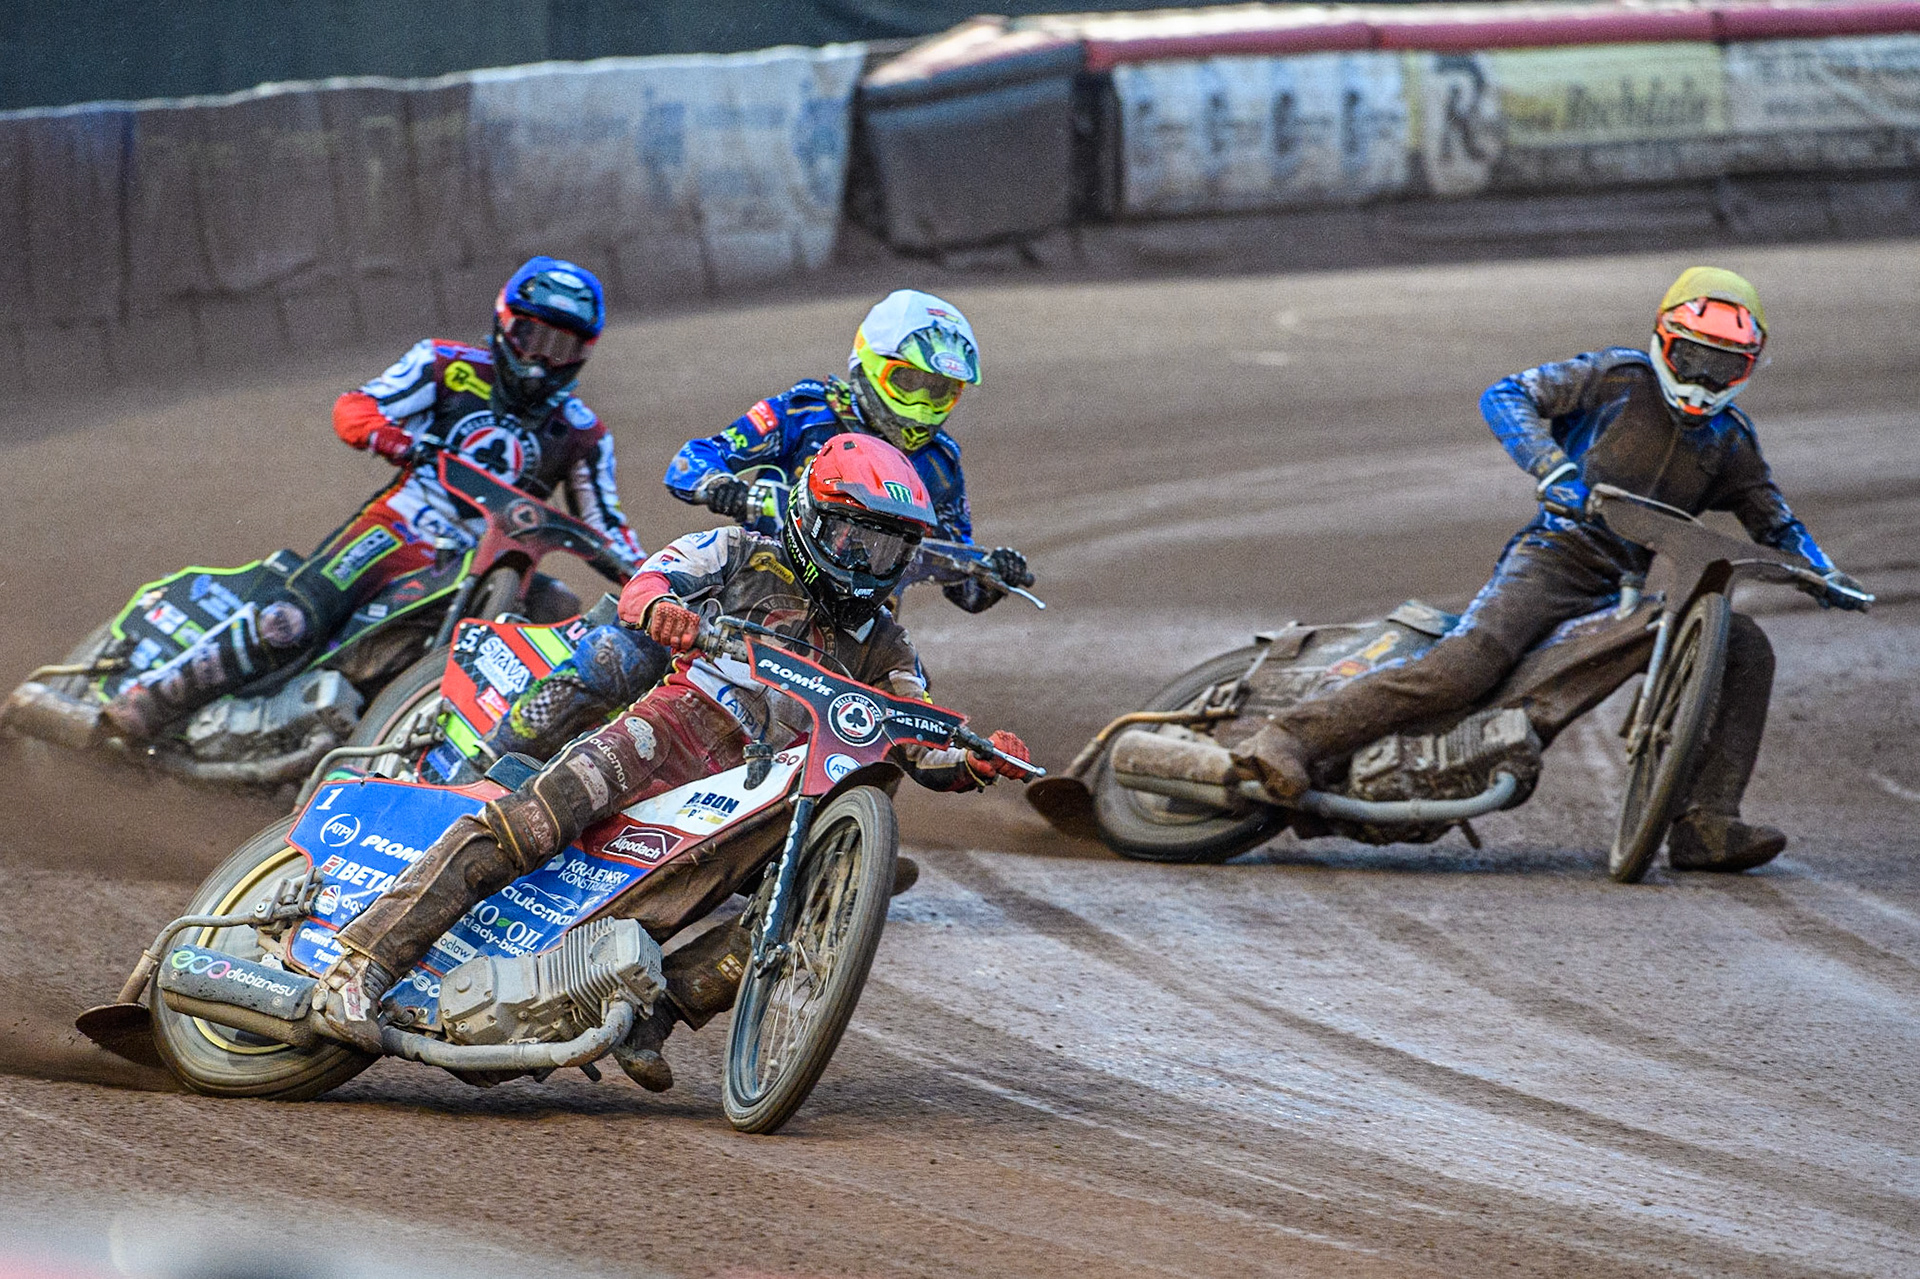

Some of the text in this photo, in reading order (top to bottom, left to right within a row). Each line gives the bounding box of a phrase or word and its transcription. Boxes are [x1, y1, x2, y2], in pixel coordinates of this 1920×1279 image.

[758, 658, 834, 697] PLOMYK
[834, 695, 853, 709] BELLE
[315, 787, 344, 810] 1
[326, 821, 354, 840] ATPI
[610, 836, 661, 860] Alpodach
[566, 858, 631, 885] KRAJEWSKI
[506, 921, 544, 951] OIL
